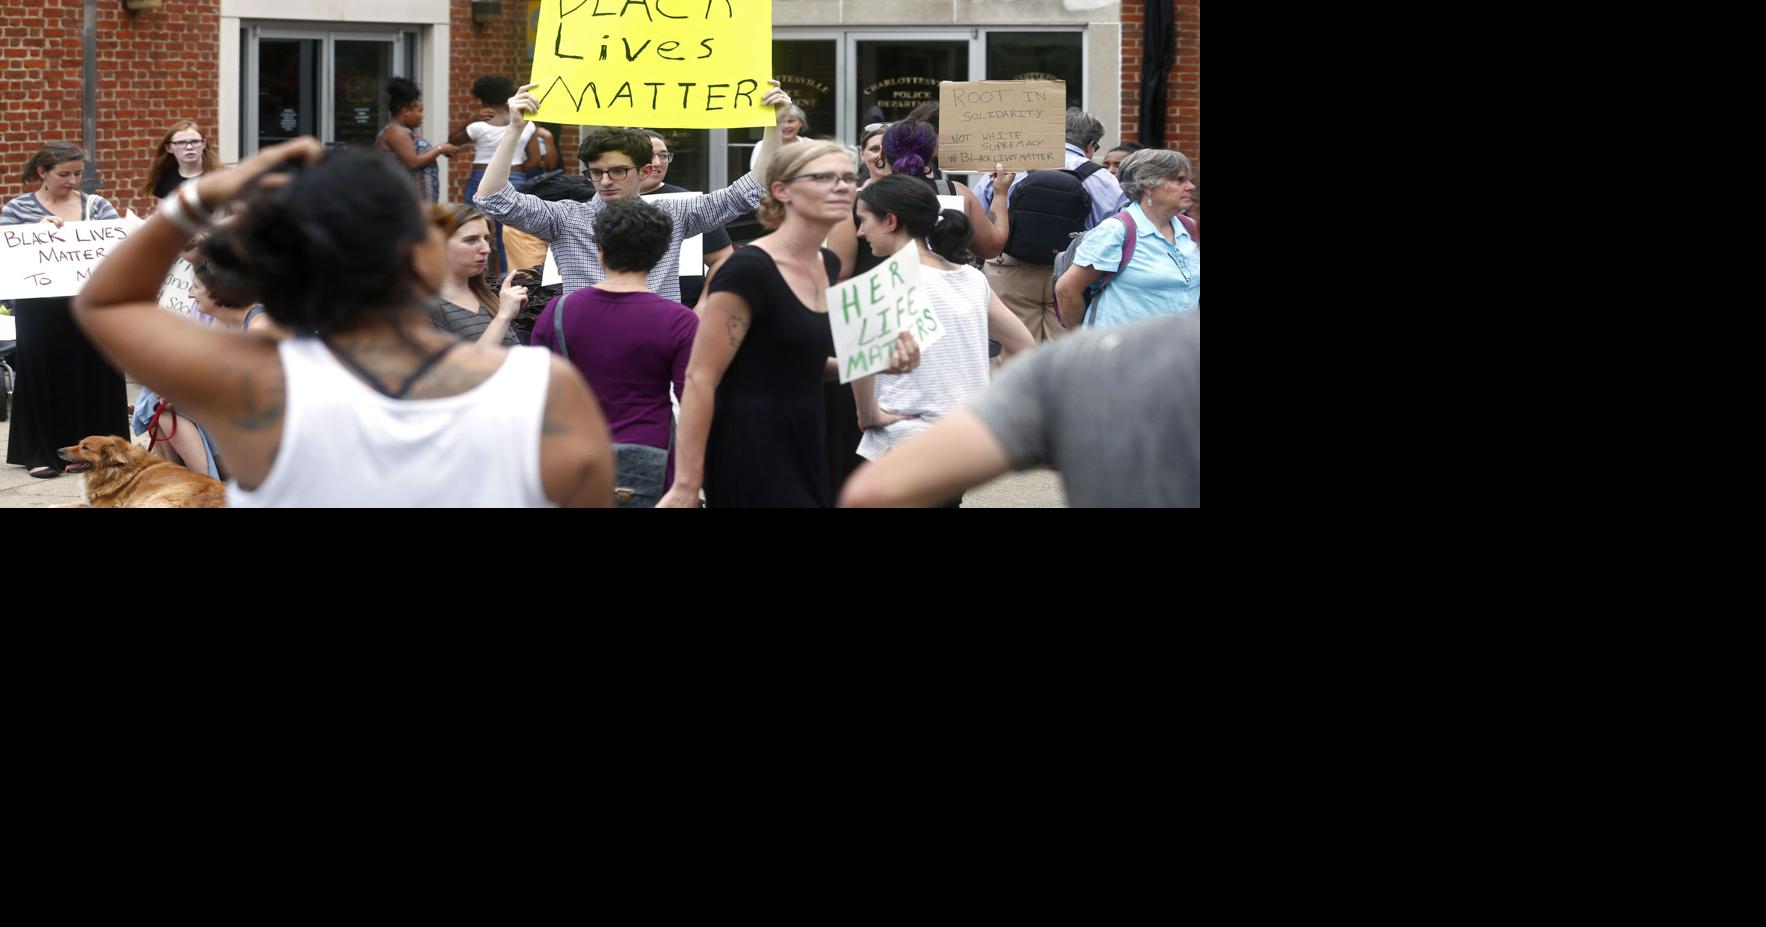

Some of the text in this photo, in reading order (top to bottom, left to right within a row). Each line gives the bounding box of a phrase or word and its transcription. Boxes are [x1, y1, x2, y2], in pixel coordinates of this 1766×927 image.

[539, 76, 758, 112] MATTER
[863, 76, 940, 95] CHARLOTTESV
[892, 91, 932, 99] POLICE
[953, 88, 1046, 107] ROOT IN
[960, 109, 1044, 122] SOLIDARITY
[951, 131, 1023, 144] NOT WHITE
[4, 226, 128, 248] BLACK LIVES
[39, 247, 107, 264] MATTER
[841, 260, 904, 325] HER
[858, 286, 918, 346] LIFE
